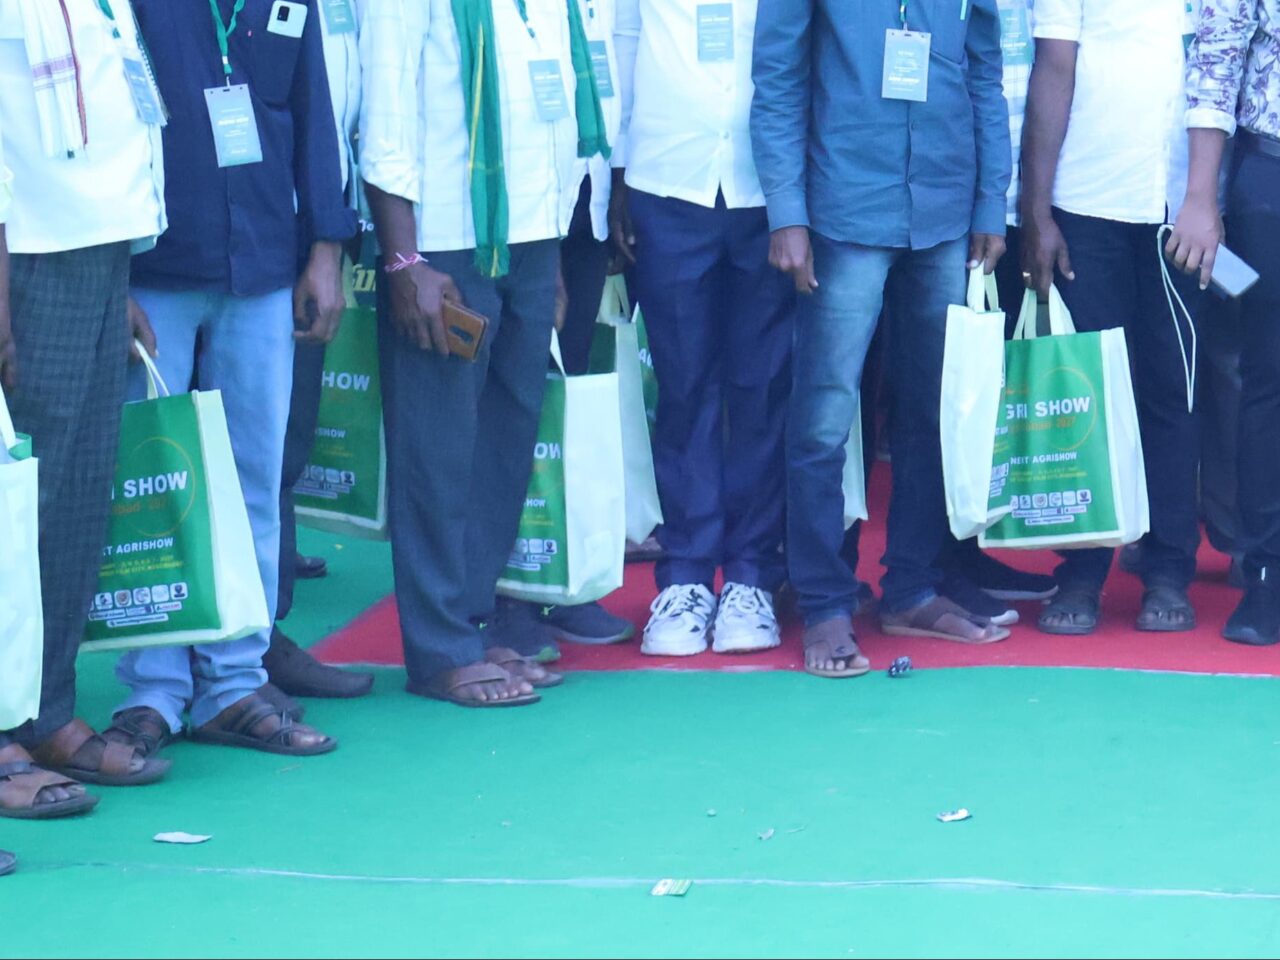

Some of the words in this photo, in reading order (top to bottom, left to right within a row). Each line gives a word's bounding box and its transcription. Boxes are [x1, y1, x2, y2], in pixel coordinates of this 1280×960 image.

[321, 371, 370, 392] HOW
[1005, 402, 1028, 421] GRI
[1034, 396, 1091, 419] SHOW
[1032, 450, 1078, 465] AGRISHOW
[123, 470, 188, 500] SHOW
[115, 536, 174, 555] AGRISHOW
